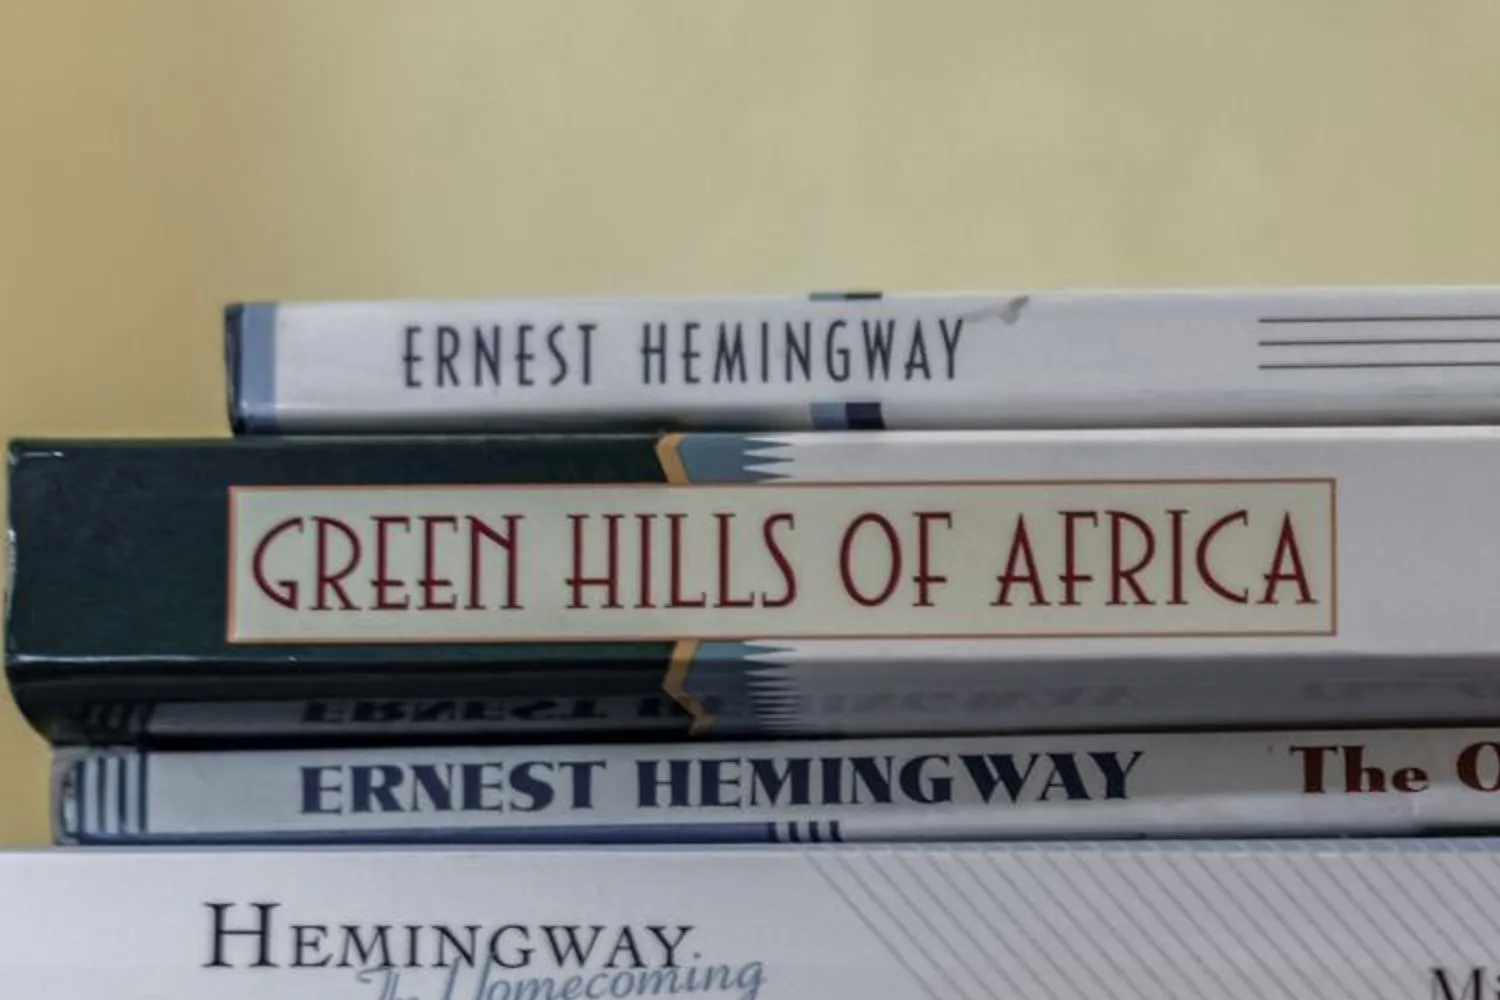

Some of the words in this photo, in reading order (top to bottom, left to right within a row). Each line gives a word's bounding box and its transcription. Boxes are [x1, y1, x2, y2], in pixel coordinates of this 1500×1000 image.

[404, 324, 598, 389] ERNEST
[641, 318, 966, 384] HEMINGWAY
[252, 514, 523, 611] GREEN
[567, 513, 798, 610] HILLS
[839, 512, 953, 608] OF
[990, 509, 1318, 608] AFRICA
[299, 760, 606, 815] ERNEST
[635, 750, 1145, 809] HEMINGWAY
[1289, 745, 1428, 795] The
[203, 902, 695, 969] HEMINGWAY
